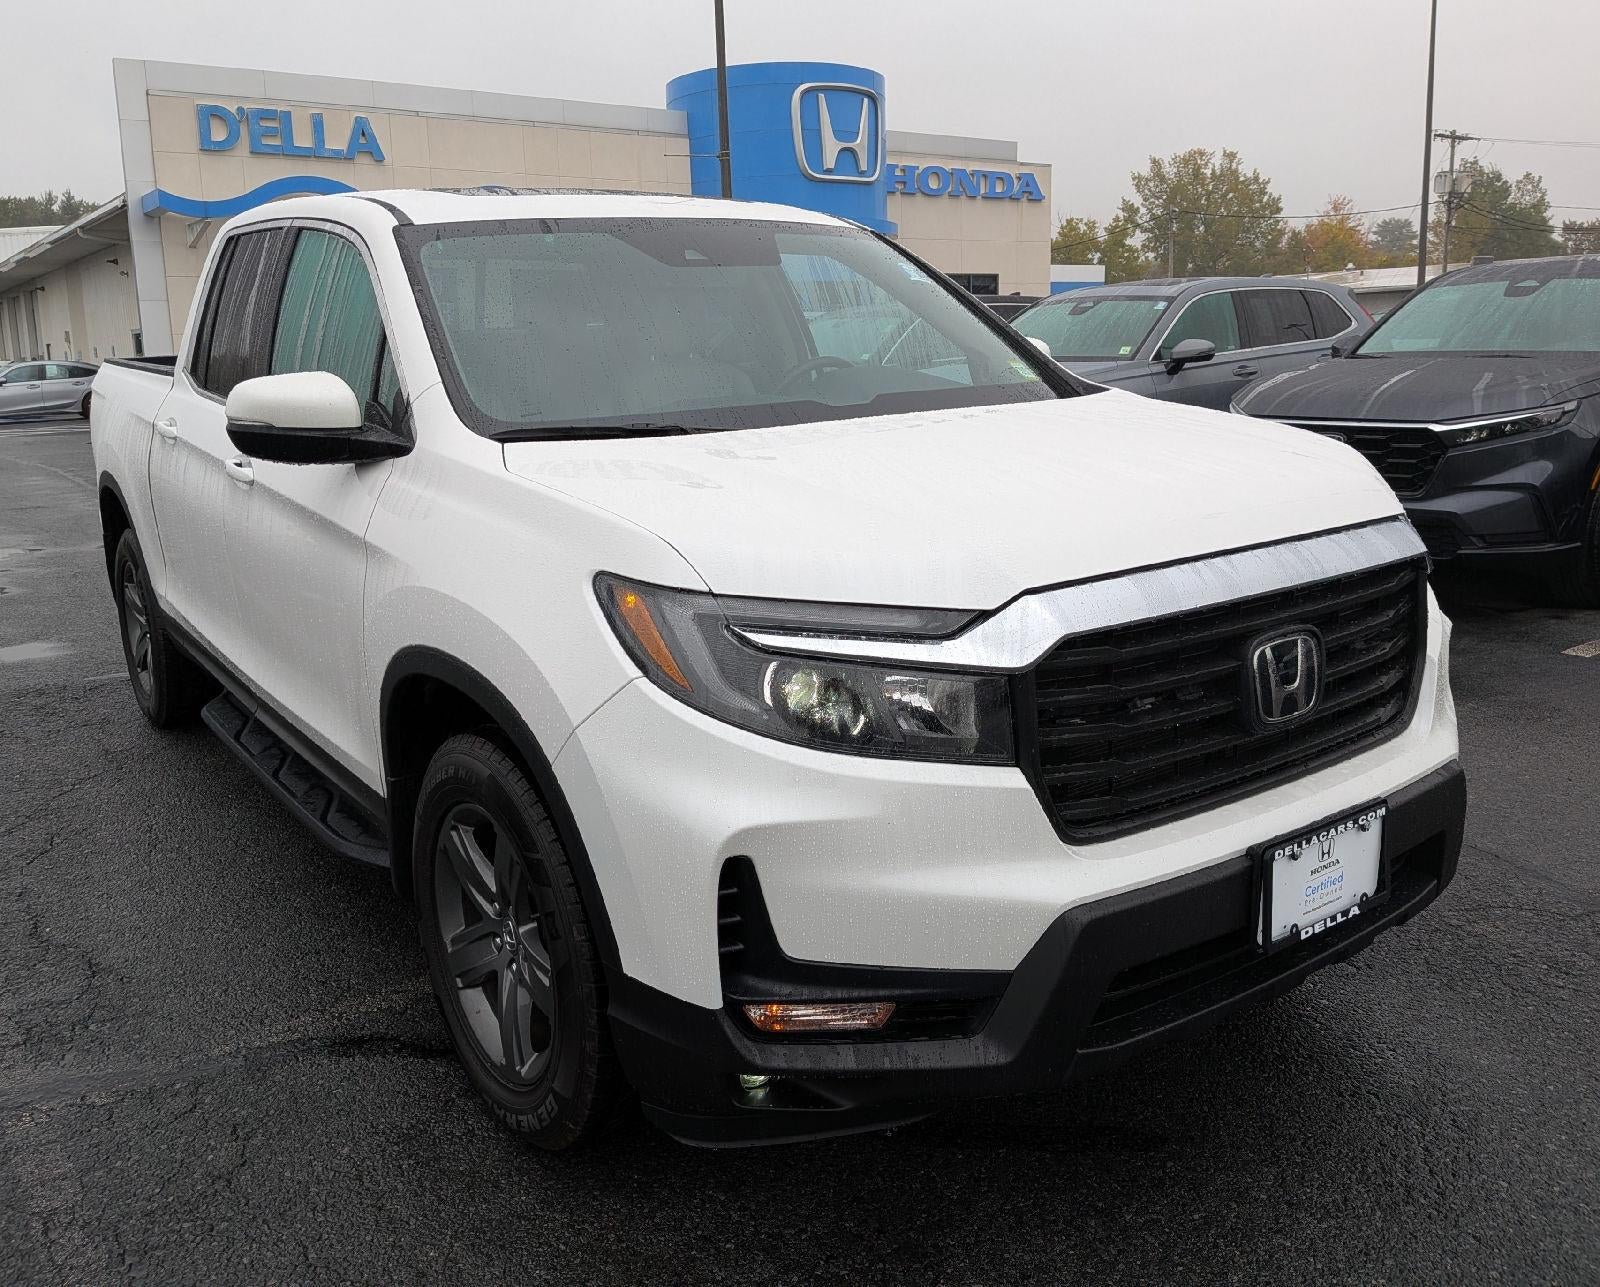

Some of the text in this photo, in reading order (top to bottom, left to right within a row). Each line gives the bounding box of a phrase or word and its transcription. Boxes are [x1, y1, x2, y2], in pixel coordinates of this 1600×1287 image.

[196, 103, 386, 162] D'ELLA
[886, 163, 1045, 200] HONDA
[1274, 806, 1386, 861] DELLACARS.COM
[1304, 870, 1344, 898] Certified
[1309, 858, 1341, 877] HONDA
[1300, 905, 1361, 941] DELLA
